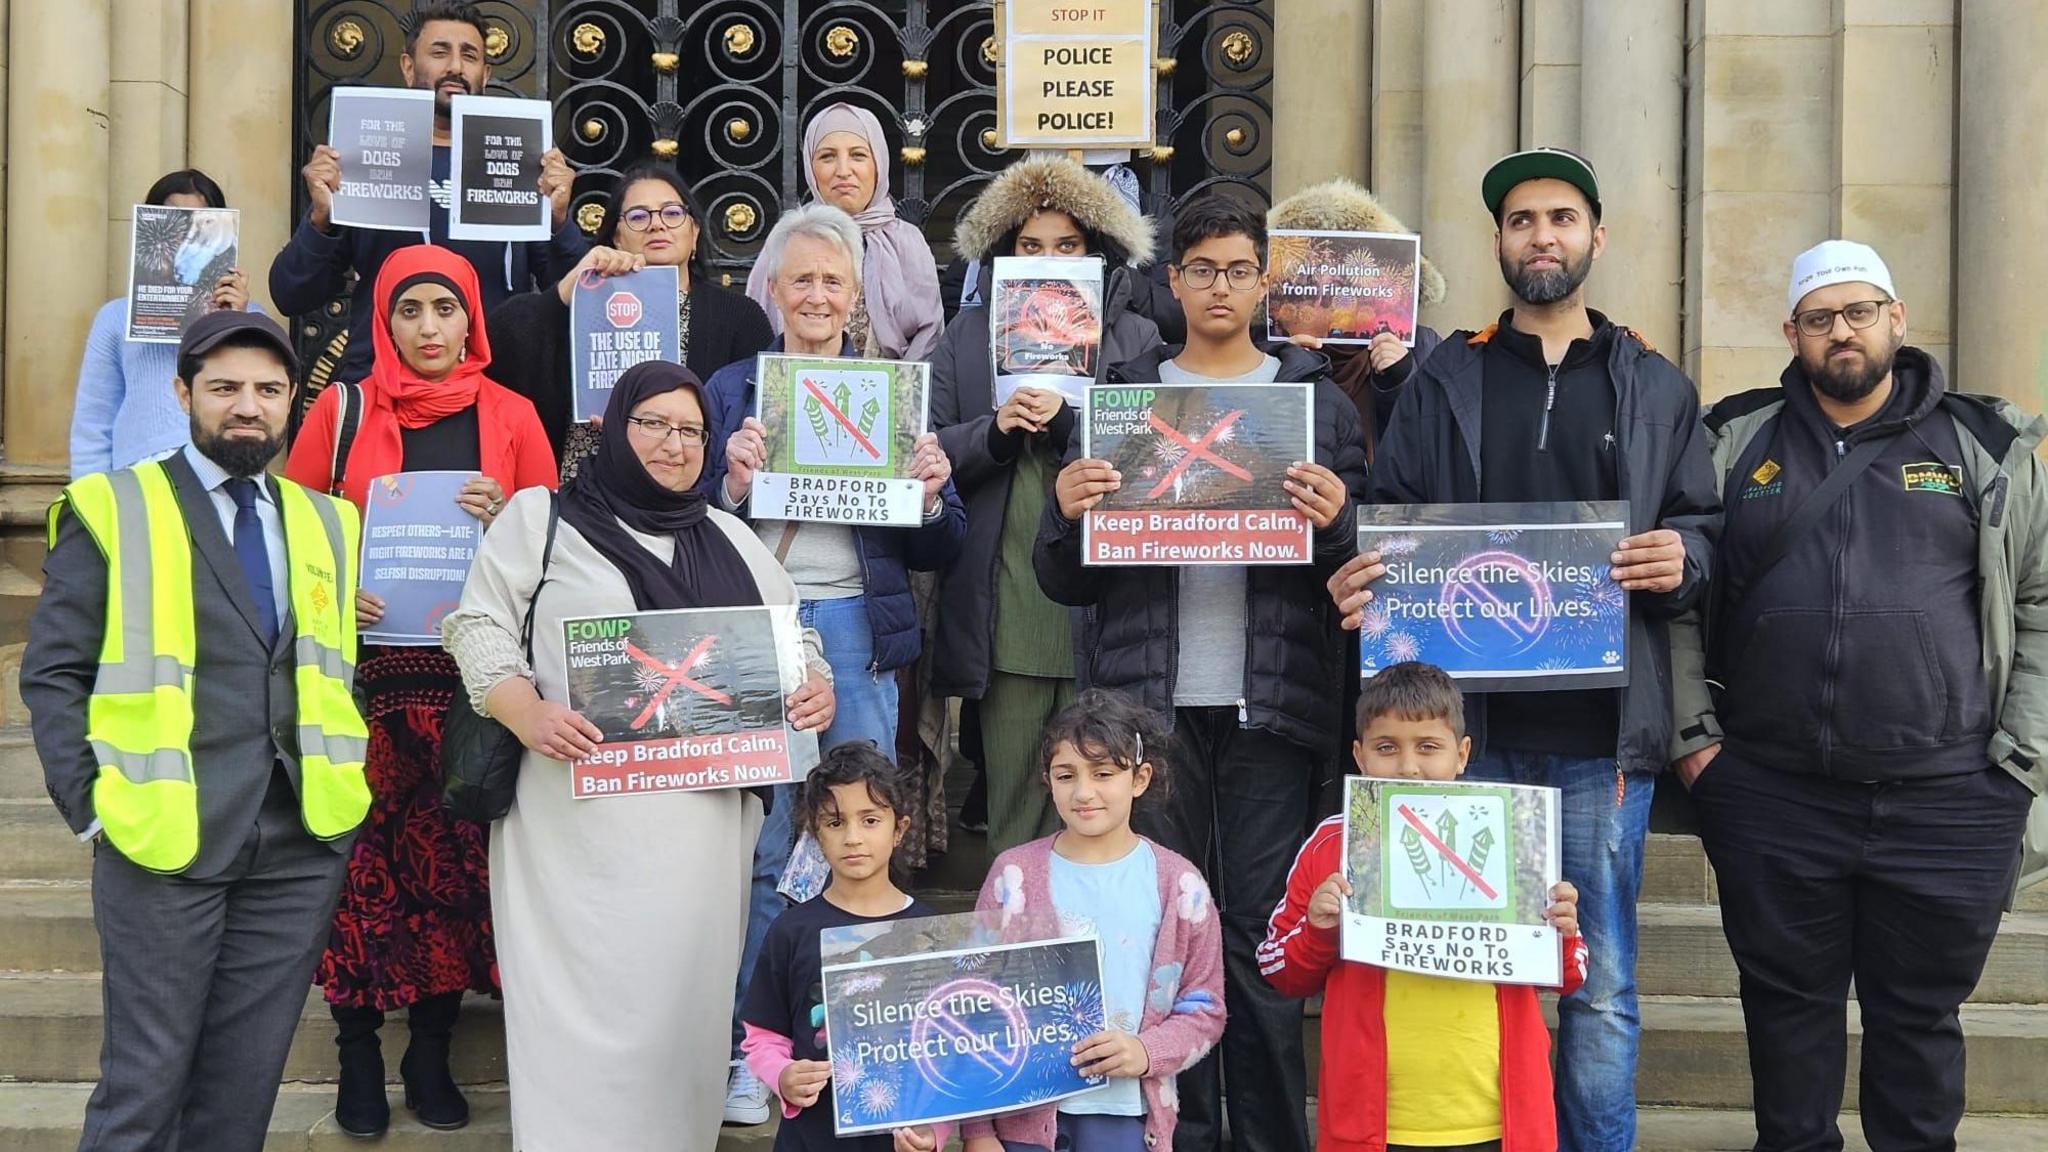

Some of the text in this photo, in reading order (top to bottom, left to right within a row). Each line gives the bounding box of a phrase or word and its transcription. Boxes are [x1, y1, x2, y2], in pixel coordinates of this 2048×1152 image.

[1052, 9, 1106, 21] STOP IT
[1043, 48, 1112, 66] POLICE
[1042, 80, 1114, 98] PLEASE
[360, 119, 405, 132] FOR THE
[1038, 112, 1114, 130] POLICE!
[484, 135, 522, 146] FOR THE
[362, 150, 401, 166] DOGS
[511, 150, 524, 160] OF
[486, 162, 520, 176] DOGS
[340, 181, 423, 200] FIREWORKS
[466, 188, 538, 204] FIREWORKS
[1298, 264, 1380, 276] Air Pollution
[148, 285, 162, 294] DIED
[164, 286, 176, 294] FOR
[176, 286, 194, 294] YOUR
[1282, 283, 1393, 298] from Fireworks
[610, 304, 638, 317] STOP
[590, 332, 660, 350] THE USE OF
[590, 351, 618, 370] LATE
[1024, 352, 1069, 361] Fireworks
[1094, 390, 1156, 408] FOWP
[1094, 408, 1152, 422] Friends of
[1094, 422, 1152, 435] West Park
[790, 477, 888, 494] BRADFORD
[788, 491, 887, 508] Says No To
[784, 505, 889, 521] FIREWORKS
[372, 525, 406, 538] RESPECT
[1094, 513, 1304, 534] Keep Bradford Calm,
[369, 546, 474, 560] NIGHT FIREWORKS ARE A
[1098, 542, 1299, 559] Ban Fireworks Now.
[374, 567, 466, 582] SELFISH DISRUPTION!
[1384, 560, 1598, 586] Silence the Skies,
[1386, 596, 1598, 620] Protect our Lives.
[567, 619, 632, 641] FOWP
[570, 636, 630, 654] Friends of
[570, 652, 632, 668] West Park
[634, 741, 723, 762] Bradford
[728, 736, 784, 754] Calm,
[582, 764, 782, 794] Ban Fireworks Now.
[1386, 922, 1508, 942] BRADFORD
[1385, 936, 1509, 960] Says No To
[1381, 950, 1514, 976] FIREWORKS
[853, 982, 1075, 1028] Silence the Skies,
[857, 1022, 1078, 1066] Protect our Lives.
